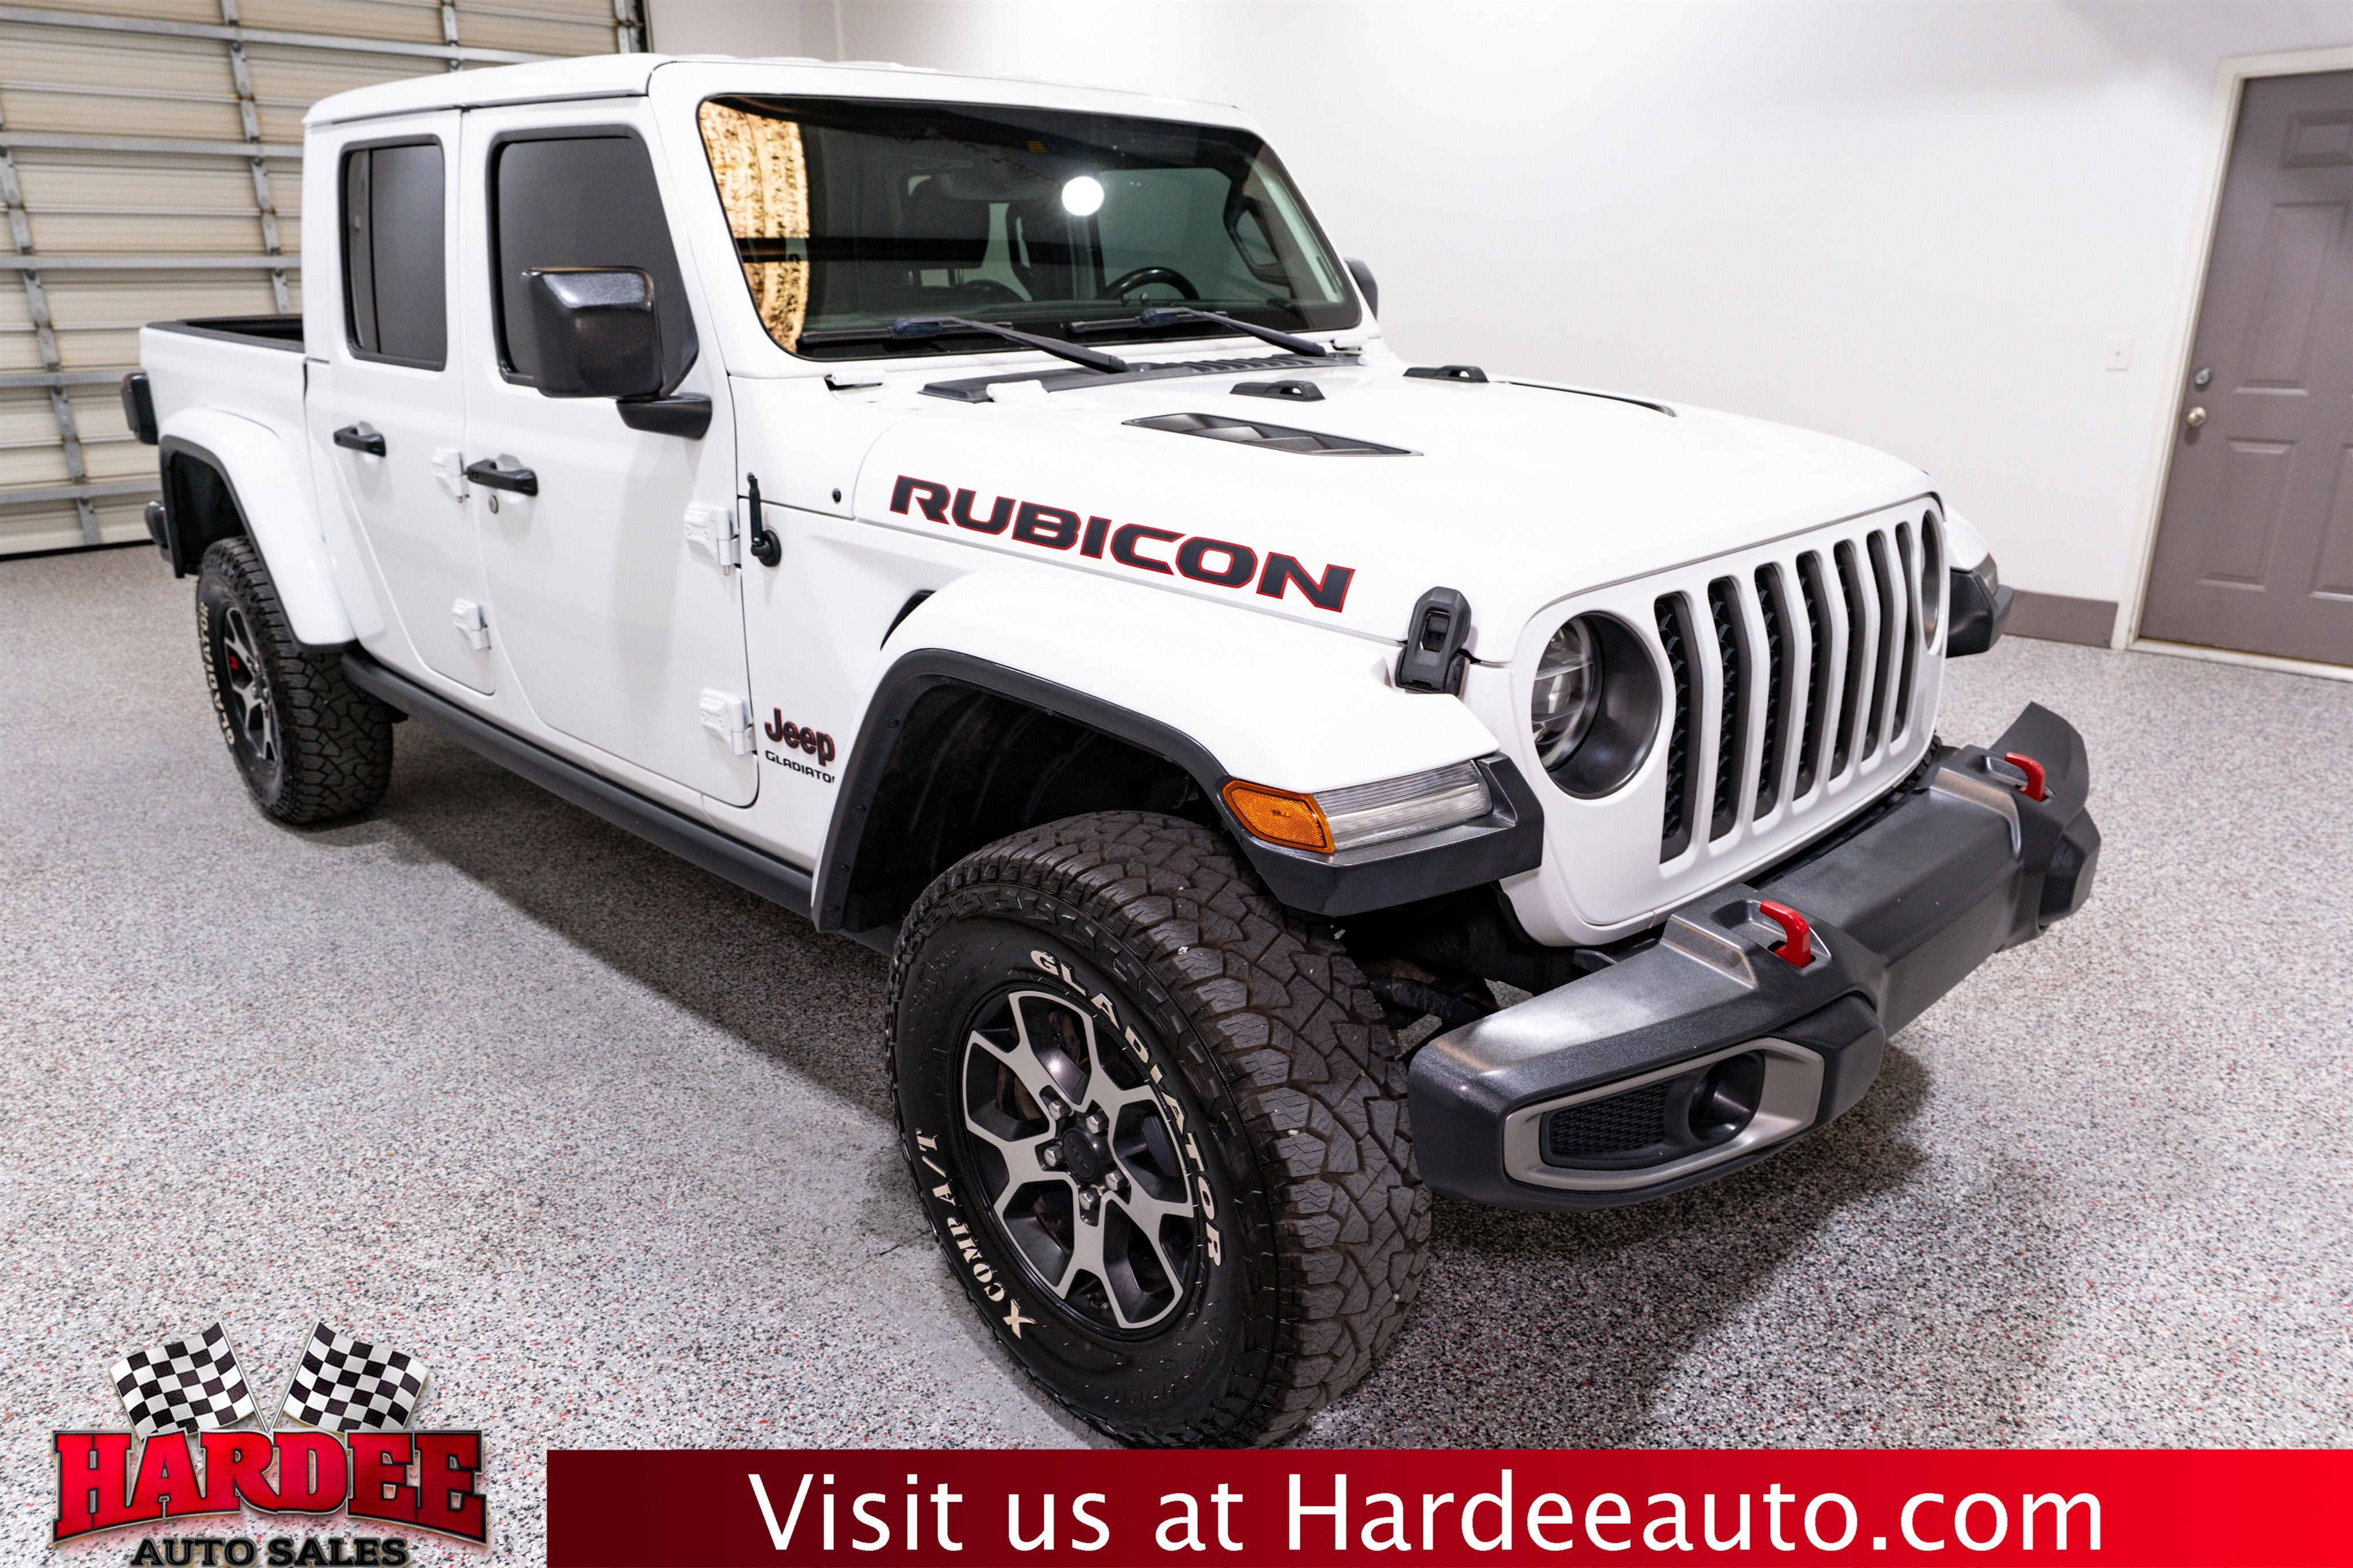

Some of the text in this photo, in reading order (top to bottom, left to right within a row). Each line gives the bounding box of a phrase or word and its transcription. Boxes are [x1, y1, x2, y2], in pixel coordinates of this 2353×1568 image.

[890, 475, 1356, 613] RUBICON
[765, 708, 835, 767] Jeep
[1031, 949, 1222, 1266] GLADIATOR
